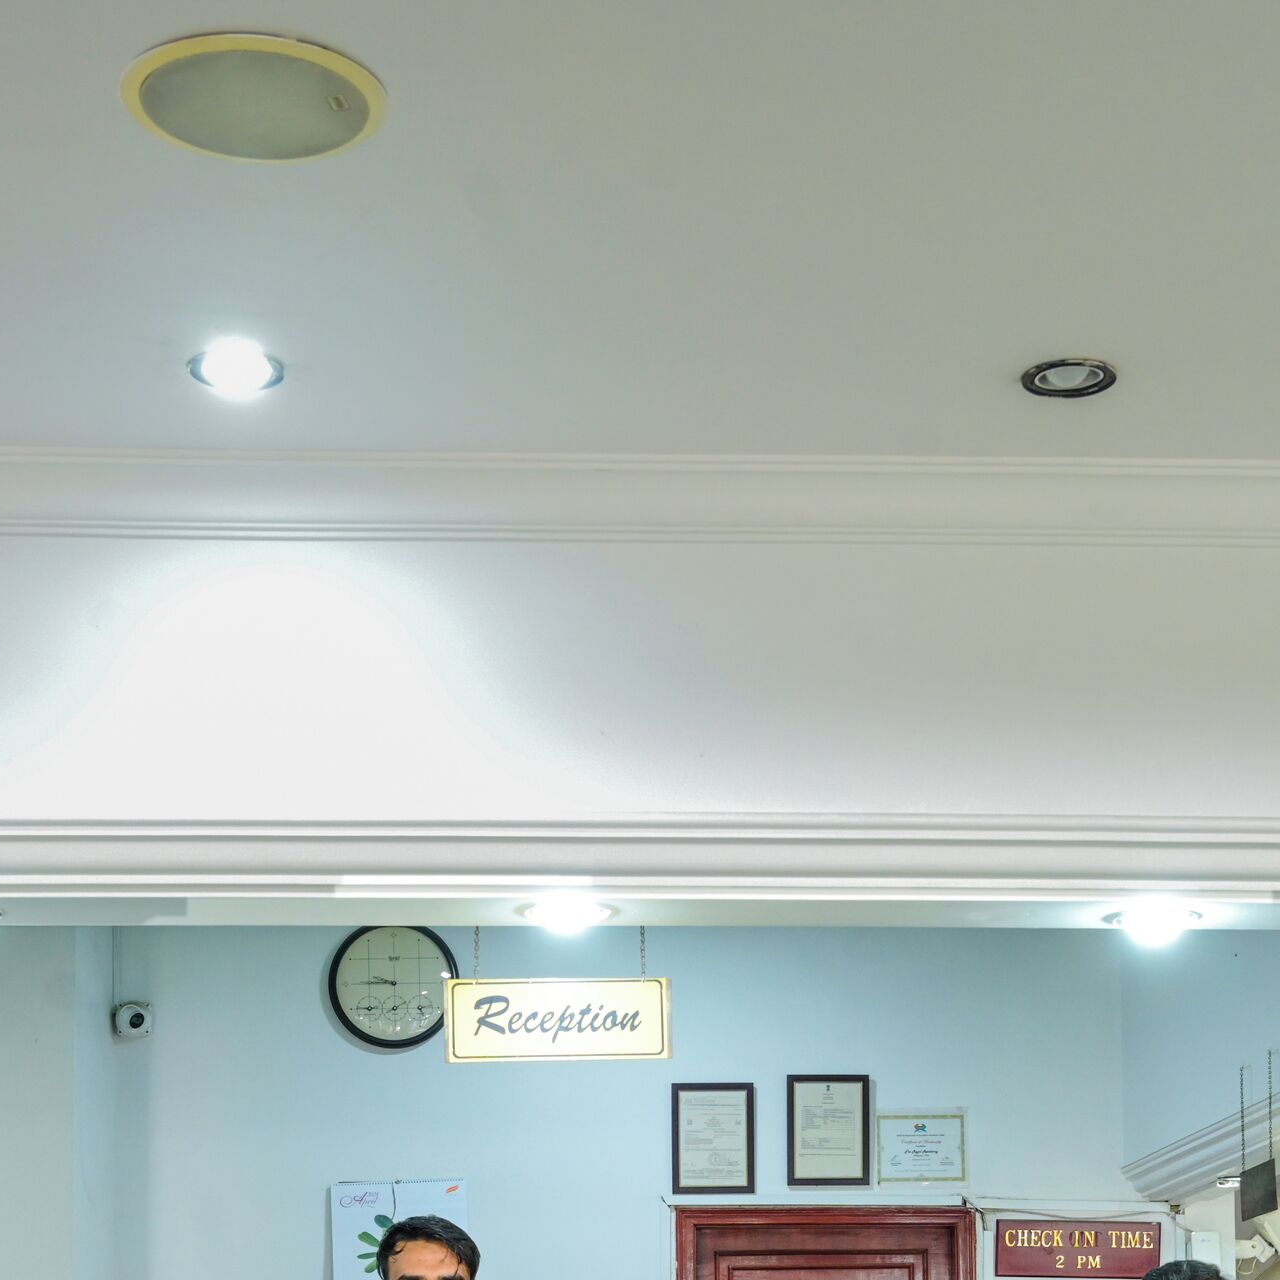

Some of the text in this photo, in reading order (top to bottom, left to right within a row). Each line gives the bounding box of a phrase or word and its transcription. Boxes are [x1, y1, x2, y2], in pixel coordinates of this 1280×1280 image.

[473, 994, 643, 1043] Reception
[1005, 1229, 1154, 1249] CHECK IN TIME
[1055, 1255, 1101, 1269] 2 PM
